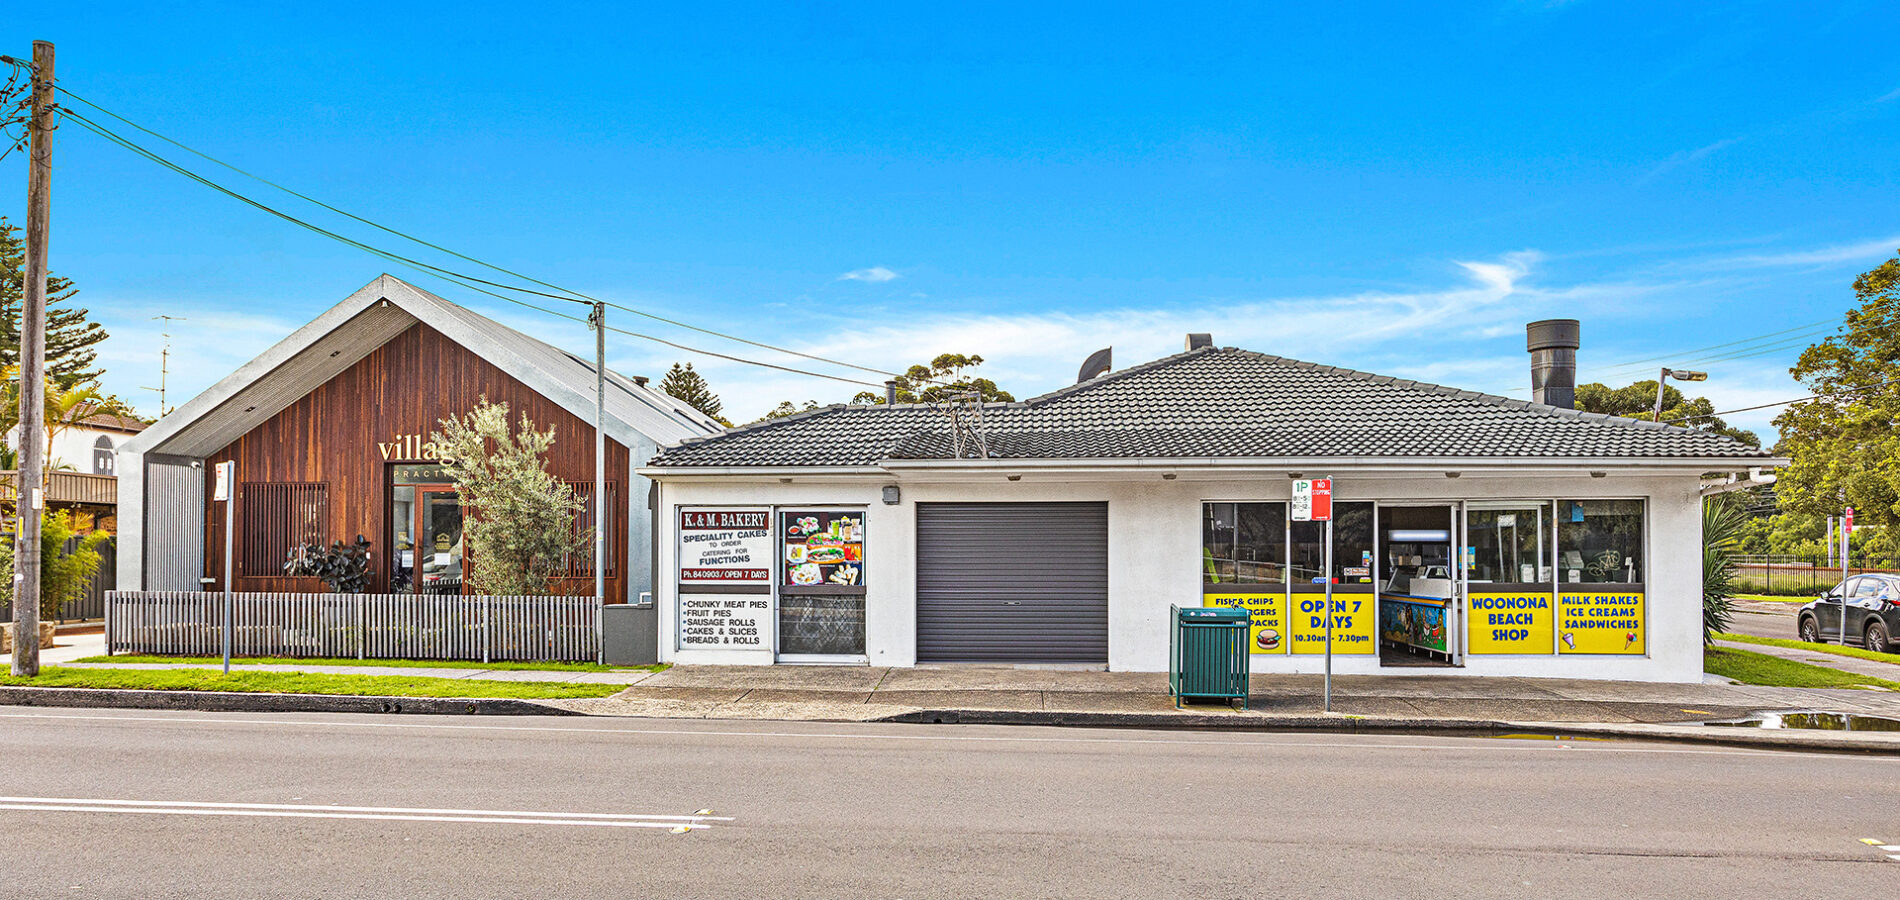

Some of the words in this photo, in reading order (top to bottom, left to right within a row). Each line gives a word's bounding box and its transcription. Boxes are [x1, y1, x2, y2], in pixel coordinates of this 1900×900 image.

[378, 433, 460, 466] villag
[1296, 482, 1308, 492] 1P
[684, 513, 696, 527] K.
[697, 513, 704, 527] &
[706, 513, 719, 527] M.
[721, 513, 766, 527] BAKERY
[683, 532, 734, 543] SPECIALITY
[737, 530, 767, 538] CAKES
[702, 549, 731, 557] CATERING
[699, 555, 750, 566] FUNCTIONS
[744, 570, 749, 578] 7
[751, 570, 767, 578] DAYS
[687, 600, 721, 608] CHUNKY
[749, 601, 768, 609] PIES
[1471, 597, 1549, 609] WOONONA
[1562, 596, 1591, 605] MILK
[1594, 596, 1639, 605] SHAKES
[1352, 601, 1362, 613] 7
[1566, 608, 1584, 617] ICE
[1588, 608, 1635, 617] CREAMS
[729, 619, 756, 627] ROLLS
[1488, 613, 1533, 625] BEACH
[1564, 620, 1639, 629] SANDWICHES
[729, 628, 757, 636] SLICES
[1492, 629, 1529, 641] SHOP
[733, 637, 760, 645] ROLLS
[1338, 634, 1369, 643] 7.30pm
